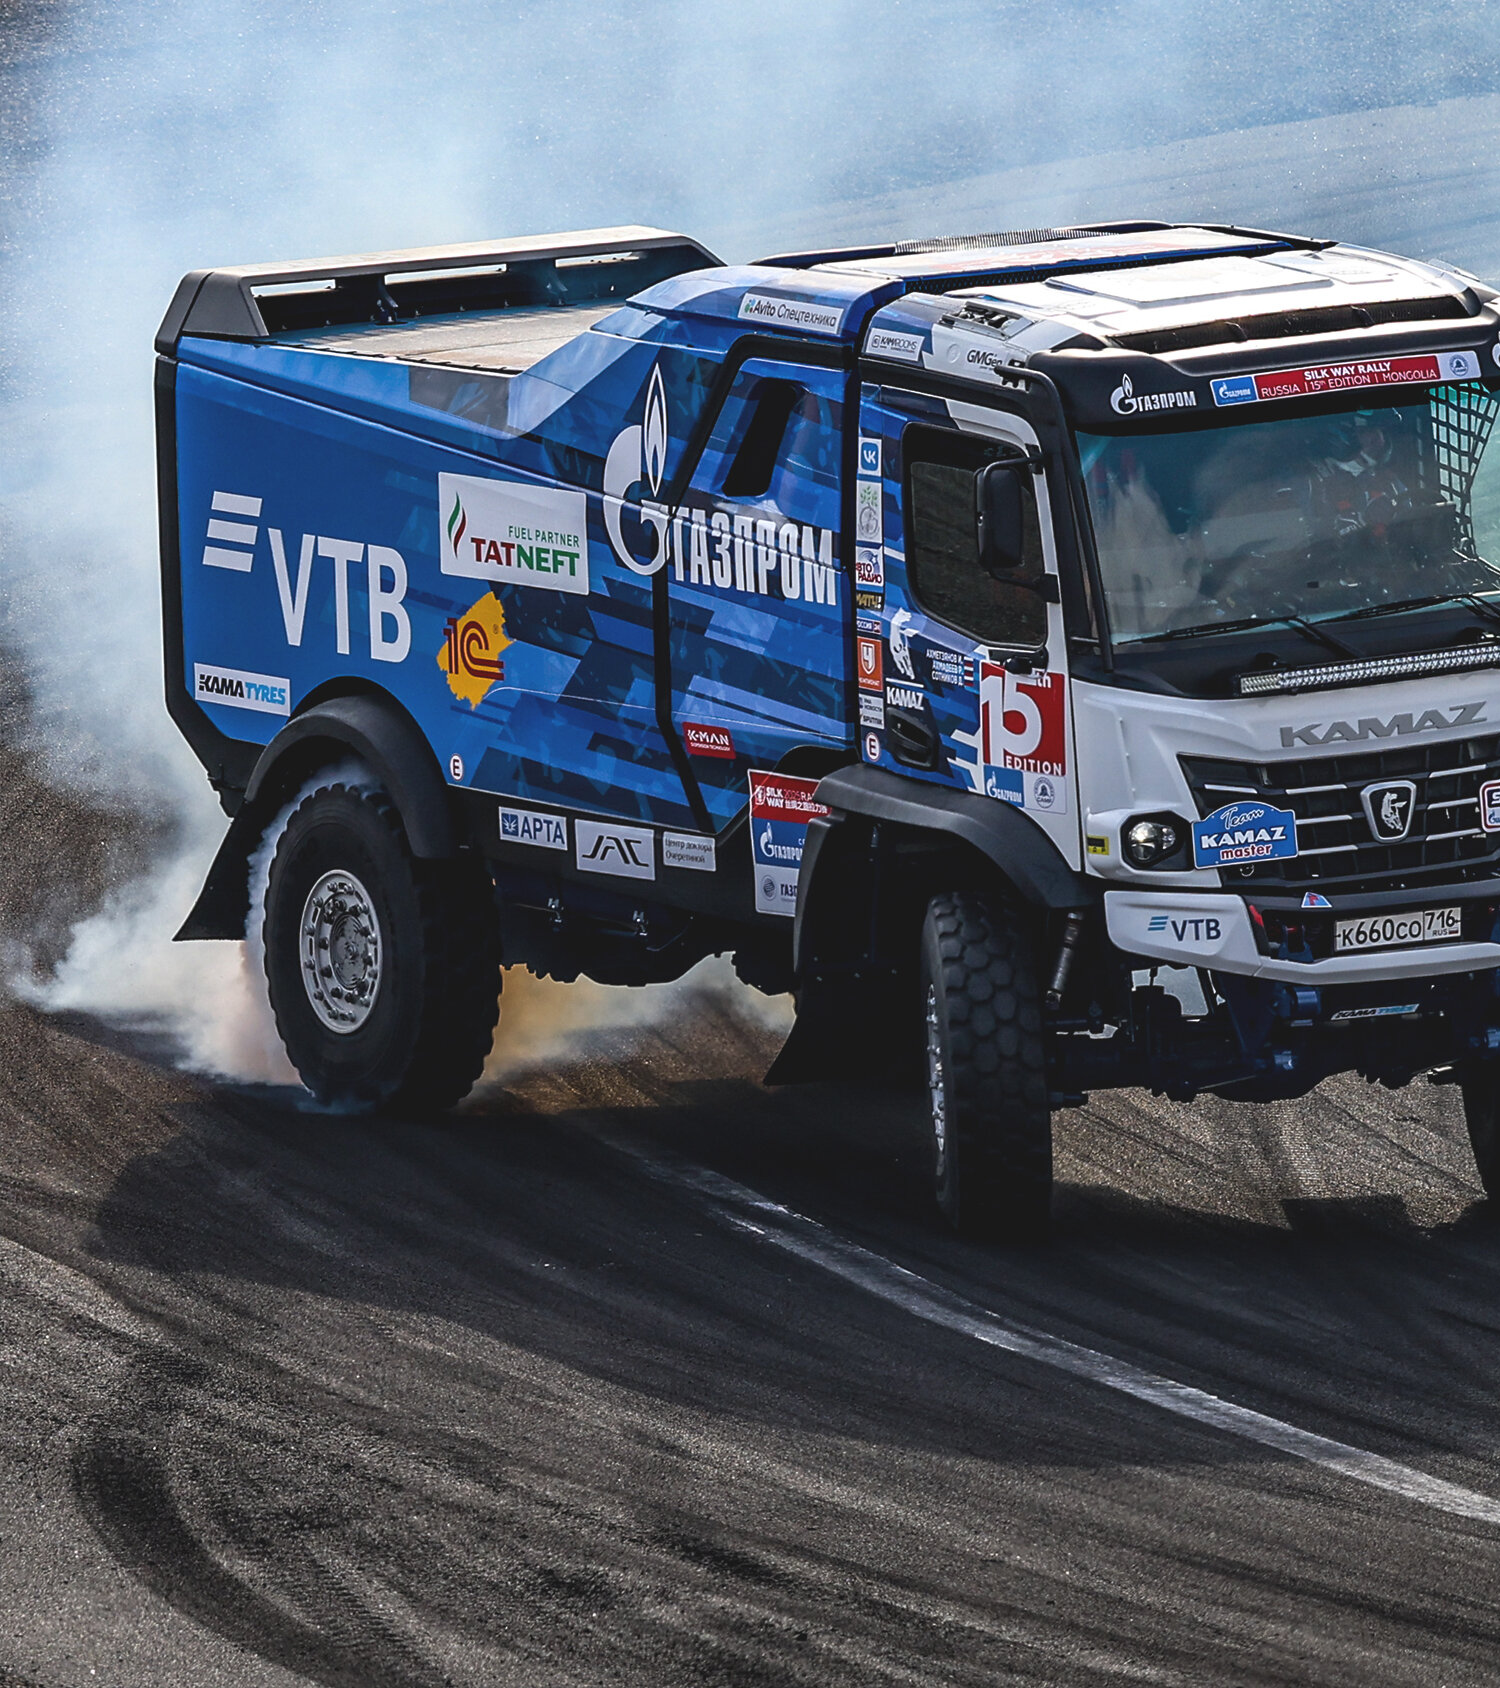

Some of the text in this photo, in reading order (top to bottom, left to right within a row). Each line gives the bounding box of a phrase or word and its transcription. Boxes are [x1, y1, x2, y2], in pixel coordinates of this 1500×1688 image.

[753, 299, 837, 327] Avito Спецтехника
[1261, 384, 1300, 398] RUSSIA
[1329, 374, 1371, 388] EDITION
[1383, 369, 1438, 382] MONGOLIA
[1304, 362, 1391, 381] SILK WAY RALLY
[1137, 390, 1197, 412] ГАЗПРОМ
[508, 525, 580, 548] FUEL PARTNER
[470, 537, 580, 577] TATNEFT
[672, 505, 838, 607] ГАЗПРОМ
[856, 562, 872, 572] ВТО
[267, 527, 412, 664] VTB
[199, 673, 286, 705] KAMA TYRES
[886, 685, 925, 711] KAMAZ
[1279, 700, 1488, 748] KAMAZ
[1005, 755, 1062, 776] EDITION
[766, 786, 783, 798] SILK
[767, 797, 784, 808] WAY
[1220, 806, 1264, 830] Team
[1201, 826, 1287, 849] KAMAZ
[582, 834, 649, 868] JAC
[774, 844, 804, 861] ГАЗПРО
[1220, 844, 1273, 861] master
[1170, 918, 1221, 942] VTB
[1342, 909, 1456, 948] K660CO 716
